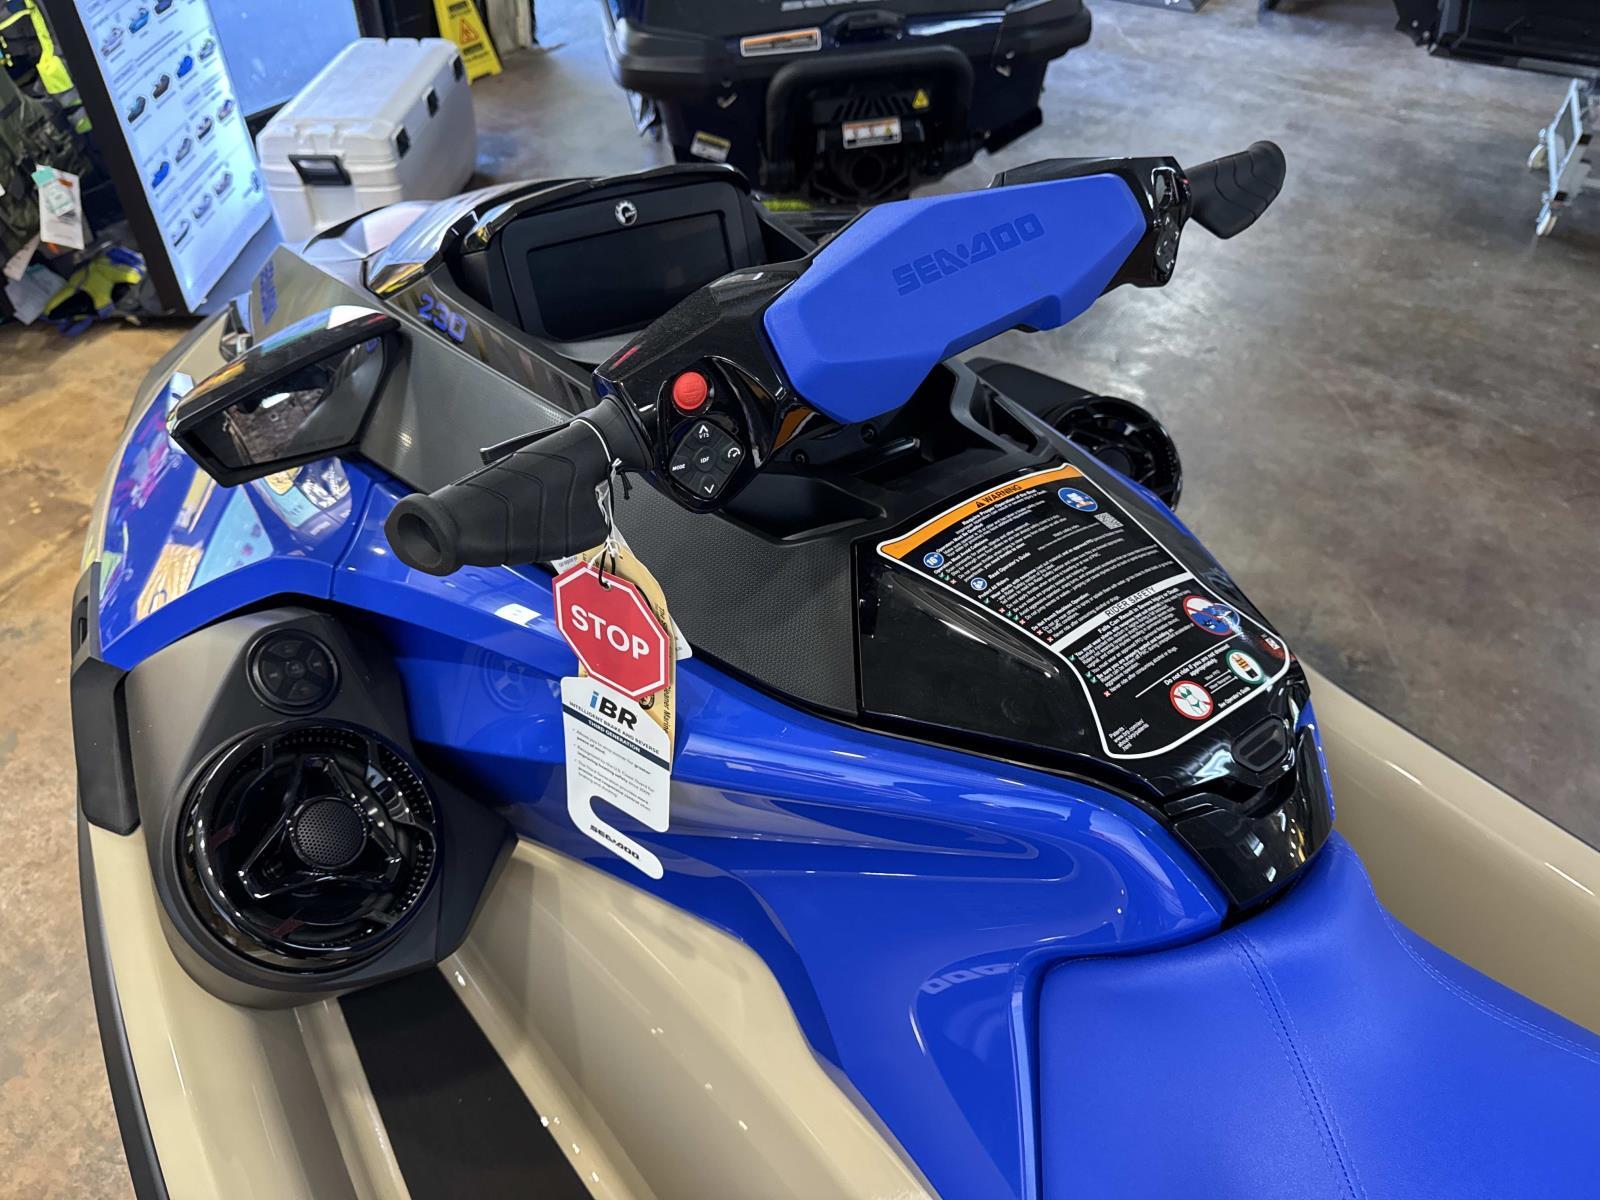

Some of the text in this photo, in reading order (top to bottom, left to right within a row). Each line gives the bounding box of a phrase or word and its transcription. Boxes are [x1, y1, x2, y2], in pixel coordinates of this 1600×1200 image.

[418, 292, 467, 342] 230
[672, 463, 686, 472] MODE
[984, 484, 1022, 503] WARNING
[1104, 600, 1128, 616] RIDER
[1128, 586, 1154, 603] SAFETY
[571, 604, 650, 660] STOP
[1179, 666, 1189, 676] ride
[1213, 643, 1229, 654] dressed
[589, 690, 638, 731] iBR
[568, 701, 659, 754] INTELLIGENT BRAKE AND REVERSE
[587, 720, 640, 752] THIRD GENERATION
